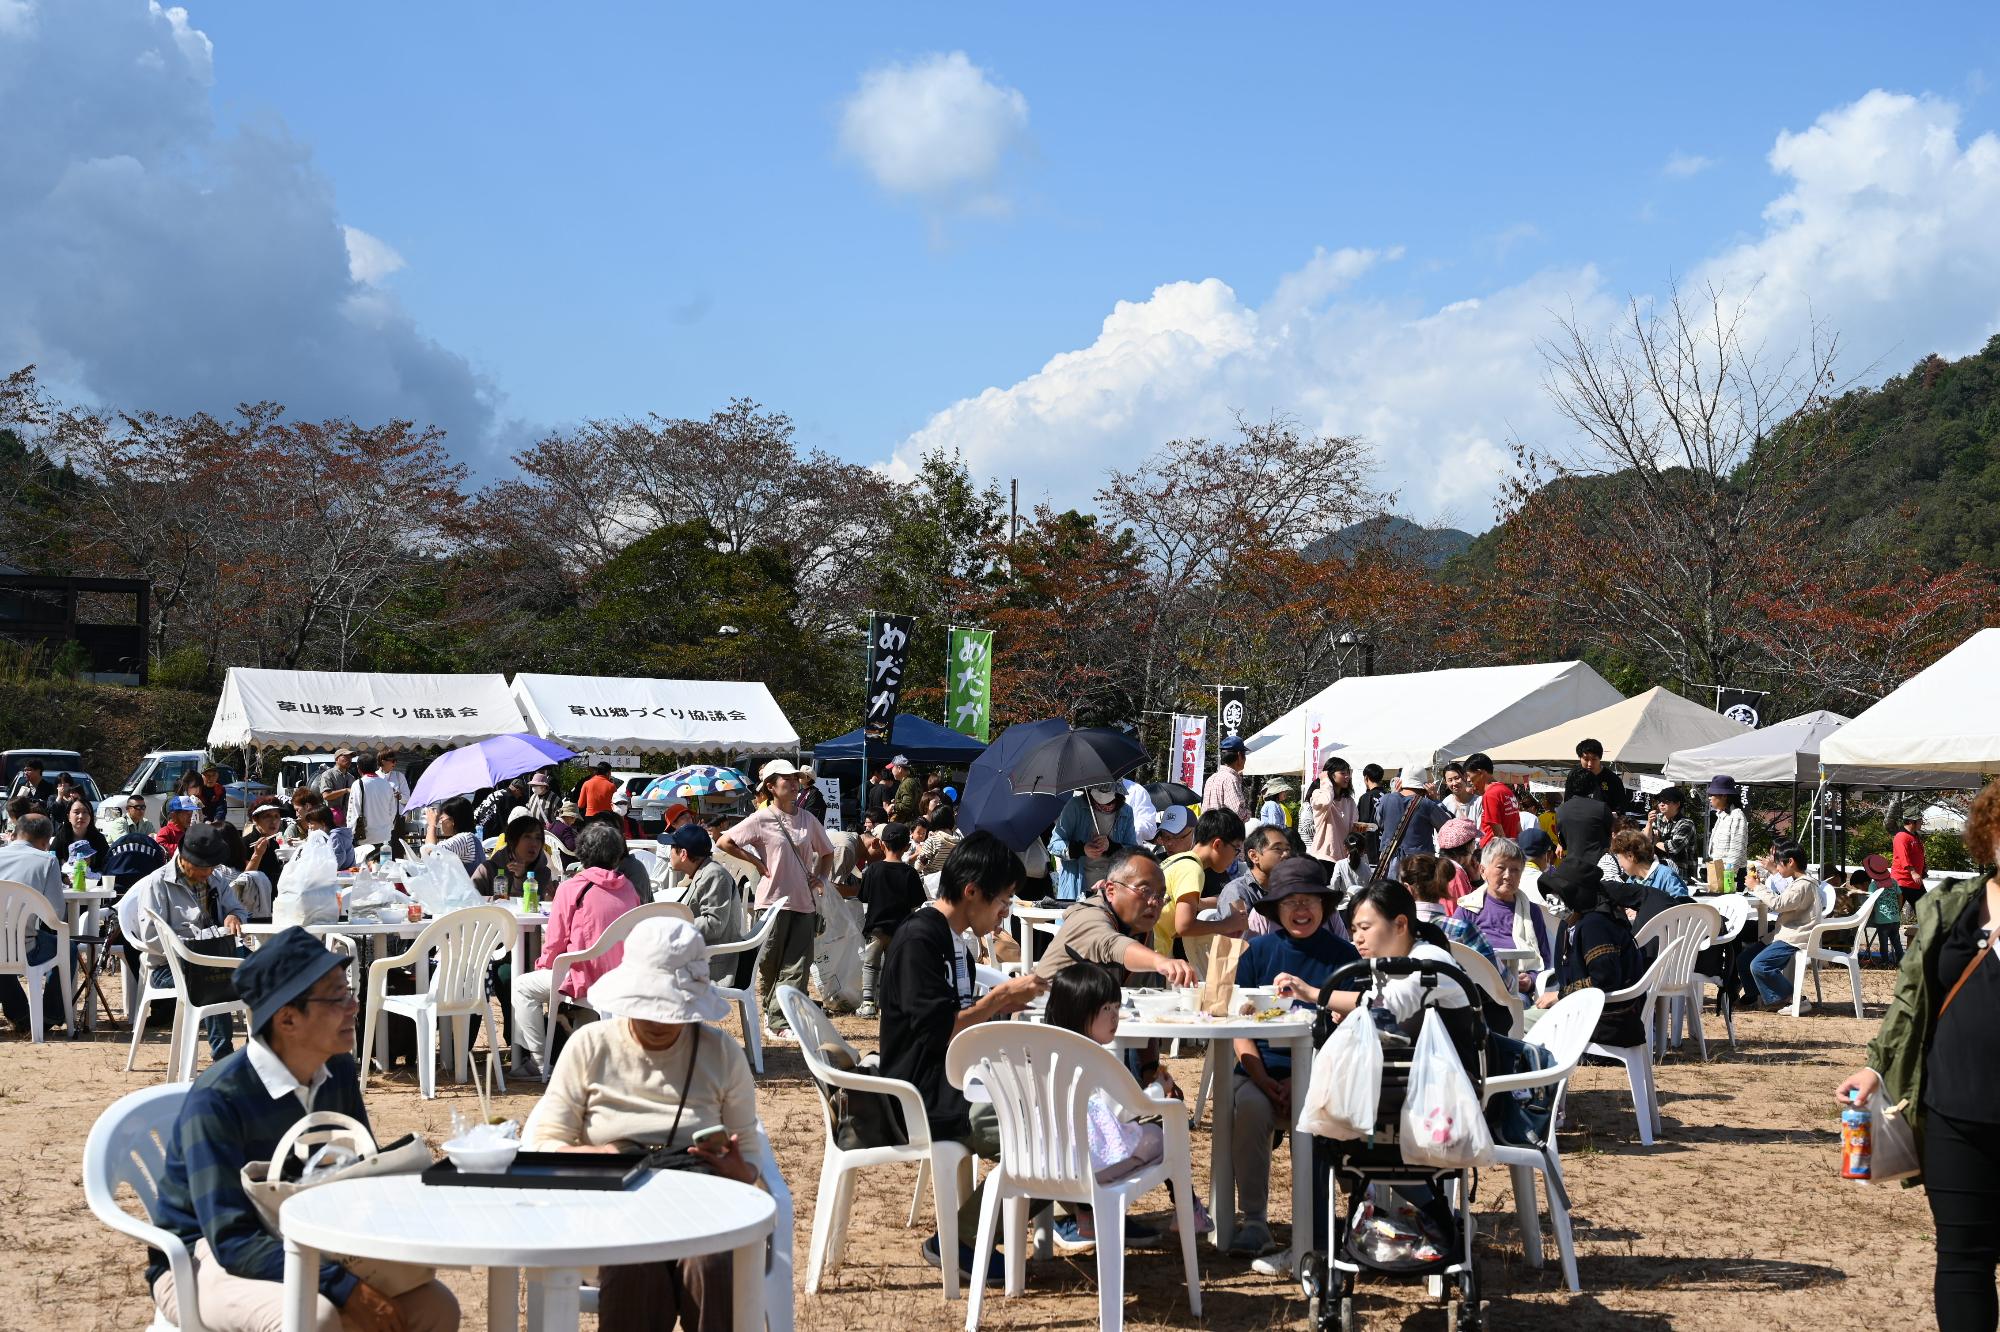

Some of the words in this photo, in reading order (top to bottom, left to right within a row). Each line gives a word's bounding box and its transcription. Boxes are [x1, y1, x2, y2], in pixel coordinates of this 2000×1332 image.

[868, 622, 906, 719] めだか
[956, 636, 987, 728] めだか
[276, 700, 479, 719] 草山郷づくり協議会
[568, 704, 748, 722] 草山郷づくり協議会
